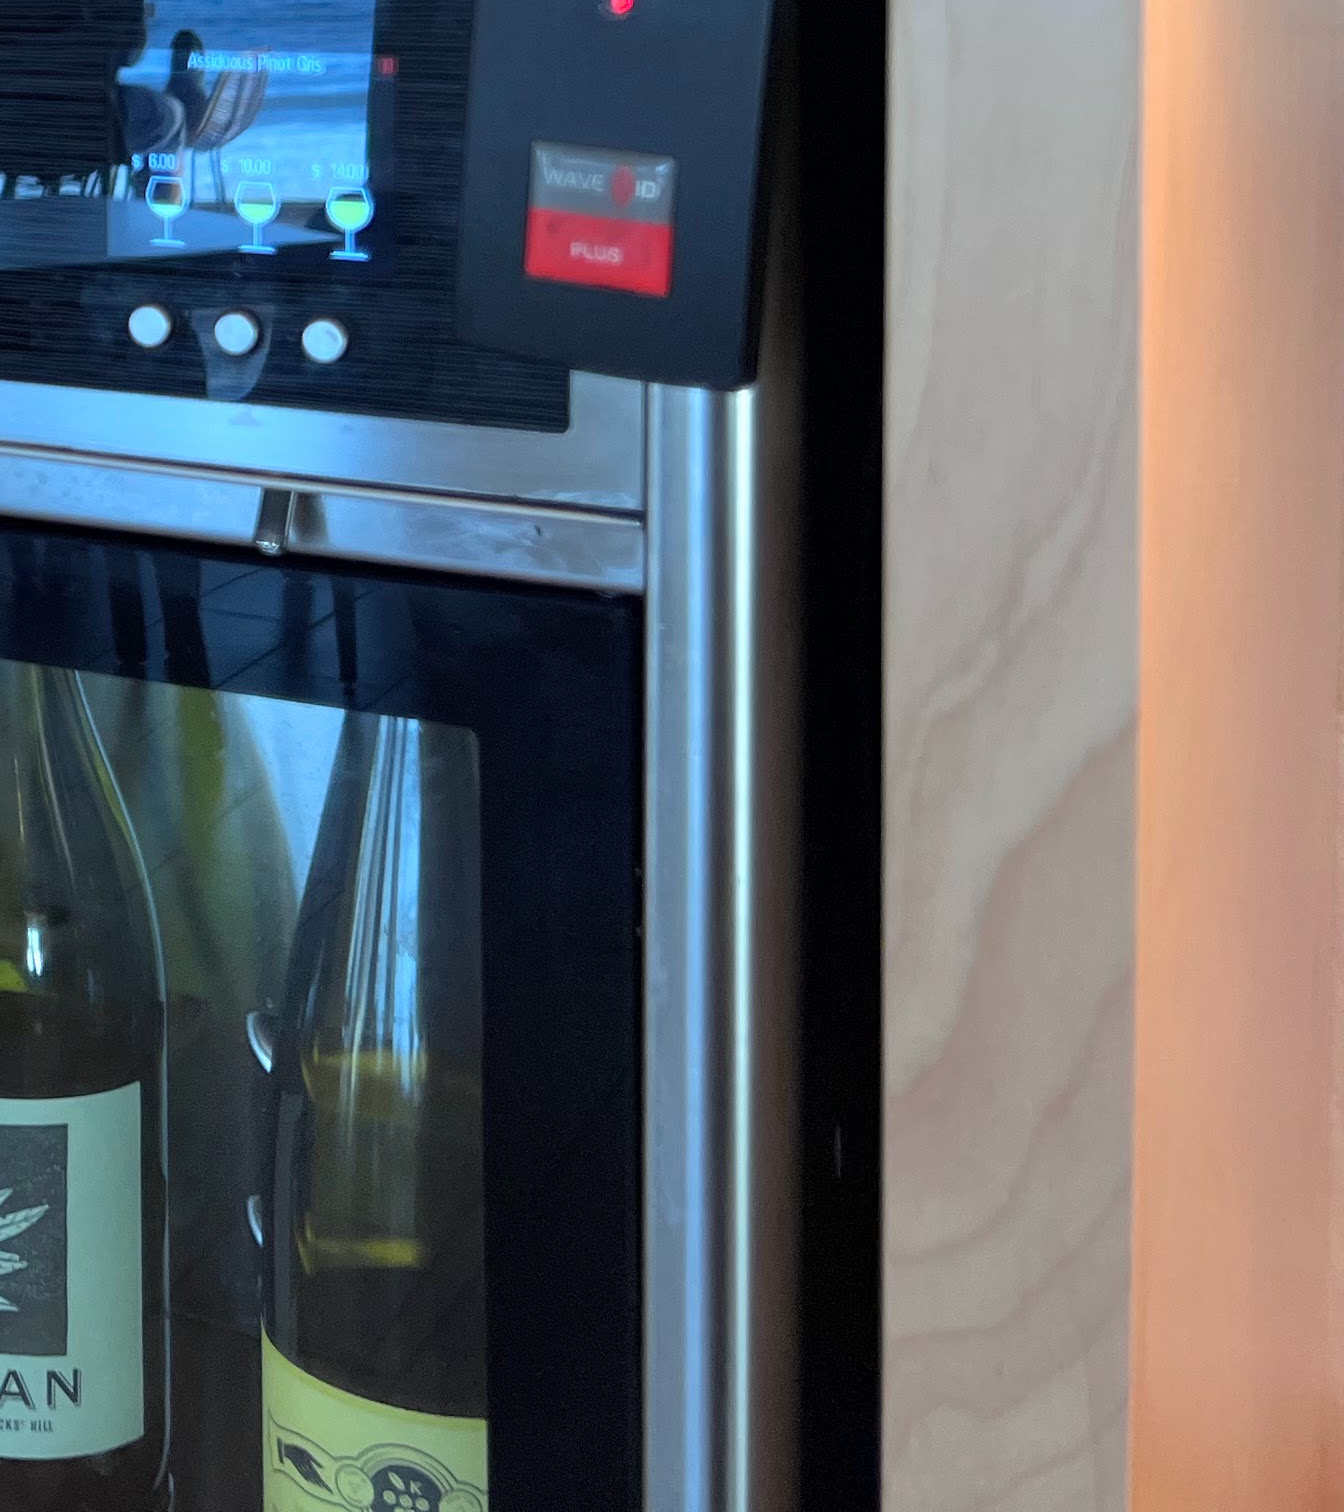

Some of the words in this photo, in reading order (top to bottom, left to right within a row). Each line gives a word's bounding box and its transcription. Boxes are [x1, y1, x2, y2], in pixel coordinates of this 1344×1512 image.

[187, 51, 253, 72] Assiduous
[257, 53, 292, 72] Pinot
[297, 54, 325, 74] Gris
[148, 153, 176, 170] 6.00
[239, 159, 272, 175] 10.00
[570, 241, 622, 264] PLUS
